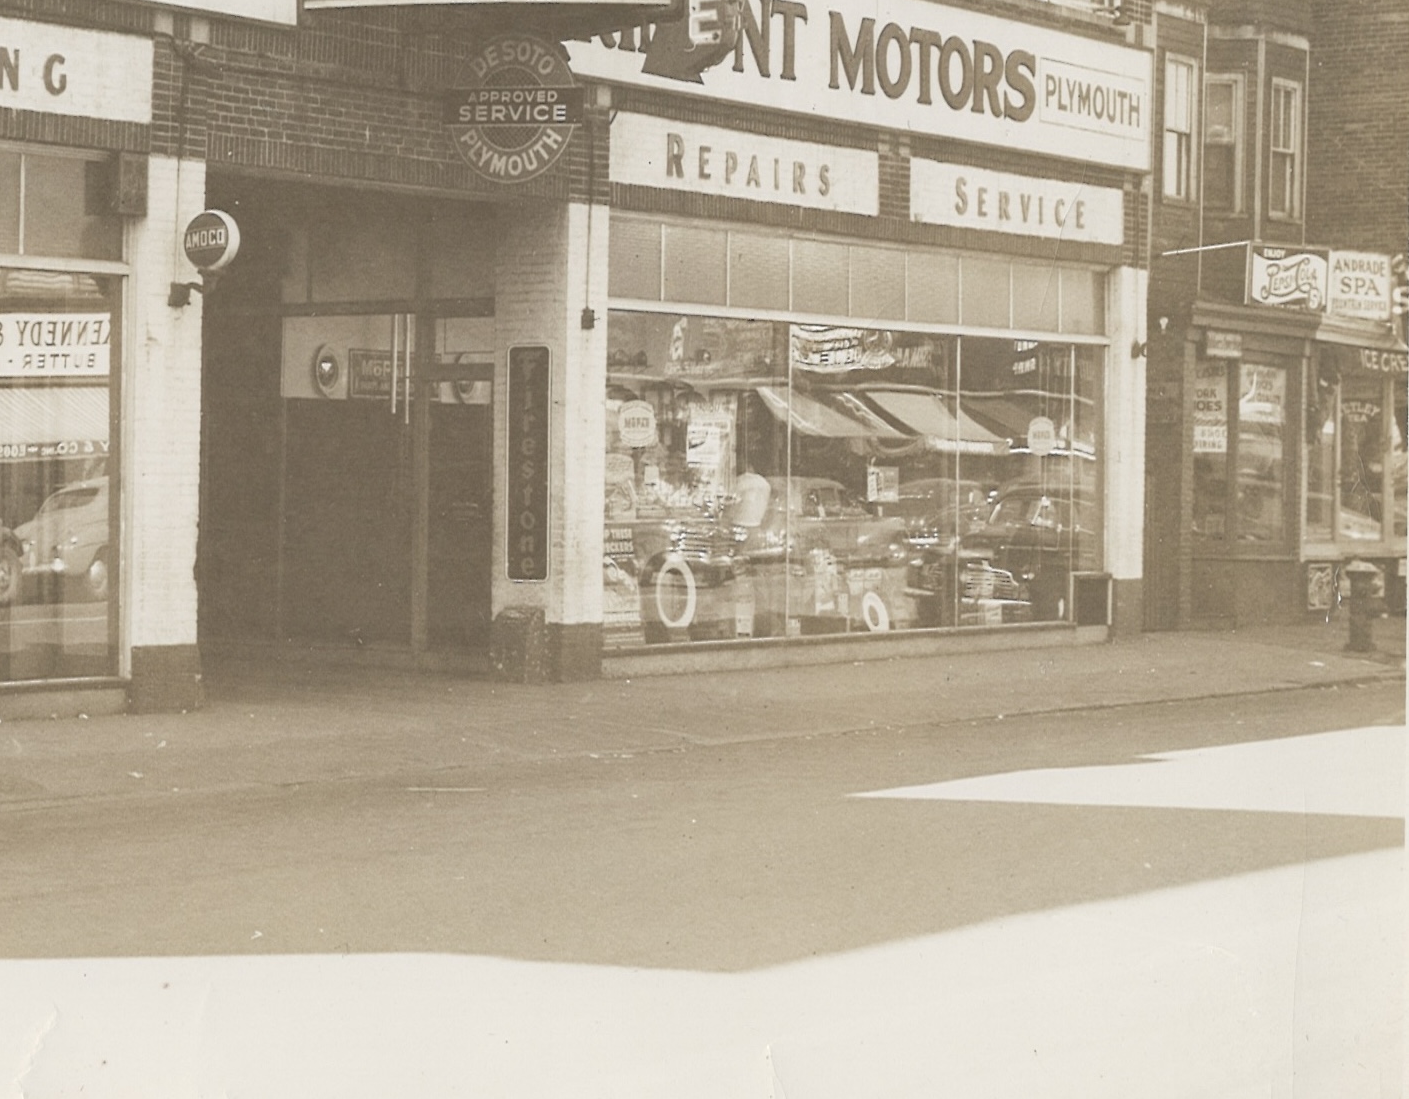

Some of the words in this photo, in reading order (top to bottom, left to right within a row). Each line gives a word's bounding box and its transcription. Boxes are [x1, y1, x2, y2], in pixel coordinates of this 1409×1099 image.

[470, 46, 500, 78] DE
[501, 40, 556, 76] SOTO
[827, 9, 1036, 123] MOTORS
[468, 90, 558, 103] APPROVED
[1045, 74, 1141, 129] PLYMOUTH
[458, 105, 567, 121] SERVICE
[460, 128, 563, 177] PLYMOUTH
[665, 132, 832, 198] REPAIRS
[954, 176, 1086, 231] SERVICE
[185, 228, 226, 250] AMOCO
[1263, 248, 1286, 258] ENJOY
[1334, 257, 1386, 277] ANDRADE
[1340, 276, 1381, 297] SPA
[1360, 348, 1379, 370] ICE
[1194, 388, 1217, 398] ORK
[1194, 401, 1222, 411] OES
[1341, 401, 1381, 417] ETLEY
